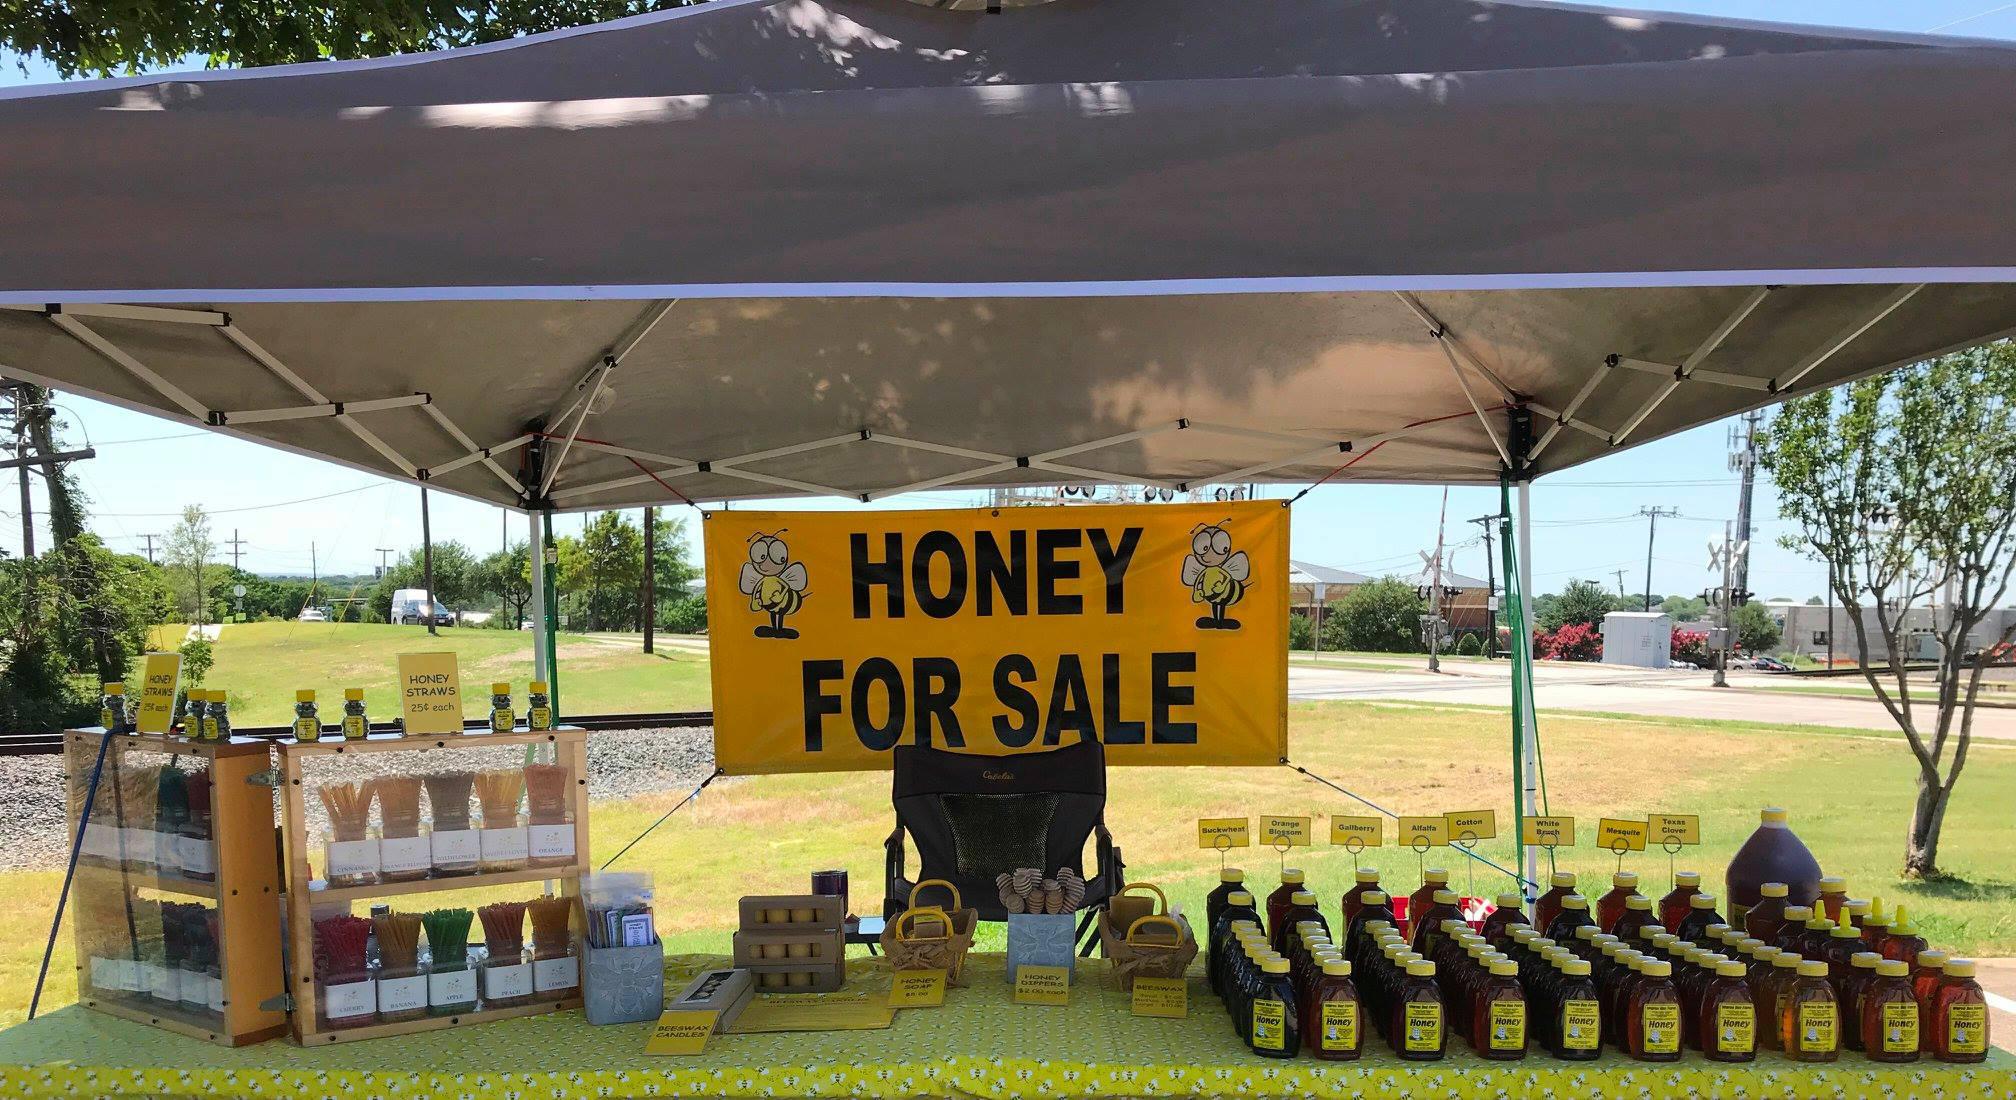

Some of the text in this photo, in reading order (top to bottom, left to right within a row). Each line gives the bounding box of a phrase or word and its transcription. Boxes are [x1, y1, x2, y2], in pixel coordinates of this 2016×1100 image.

[850, 527, 1144, 619] HONEY
[149, 675, 173, 684] HONEY
[409, 674, 450, 685] HONEY
[144, 687, 173, 697] STRAWS
[406, 686, 456, 697] STRAWS
[802, 651, 1198, 752] FOR SALE
[155, 704, 168, 712] each
[411, 702, 455, 713] 25¢ each
[1271, 820, 1300, 828] Orange
[1338, 824, 1375, 833] Gallberry
[1411, 824, 1437, 832] Alfalfa
[1202, 826, 1245, 834] Buckwheat
[1268, 828, 1302, 836] Blossom
[1606, 827, 1641, 836] Mesquite
[1136, 984, 1184, 992] BEESWAX
[1256, 1015, 1281, 1026] Honey
[1326, 1017, 1352, 1027] Honey
[1410, 1018, 1436, 1028] Honey
[1495, 1017, 1521, 1027] Honey
[1569, 1016, 1595, 1026] Honey
[1648, 1020, 1675, 1030] Honey
[1723, 1019, 1750, 1029] Honey
[1806, 1018, 1832, 1028] Honey
[1888, 1019, 1914, 1029] Honey
[1954, 1019, 1981, 1030] Honey
